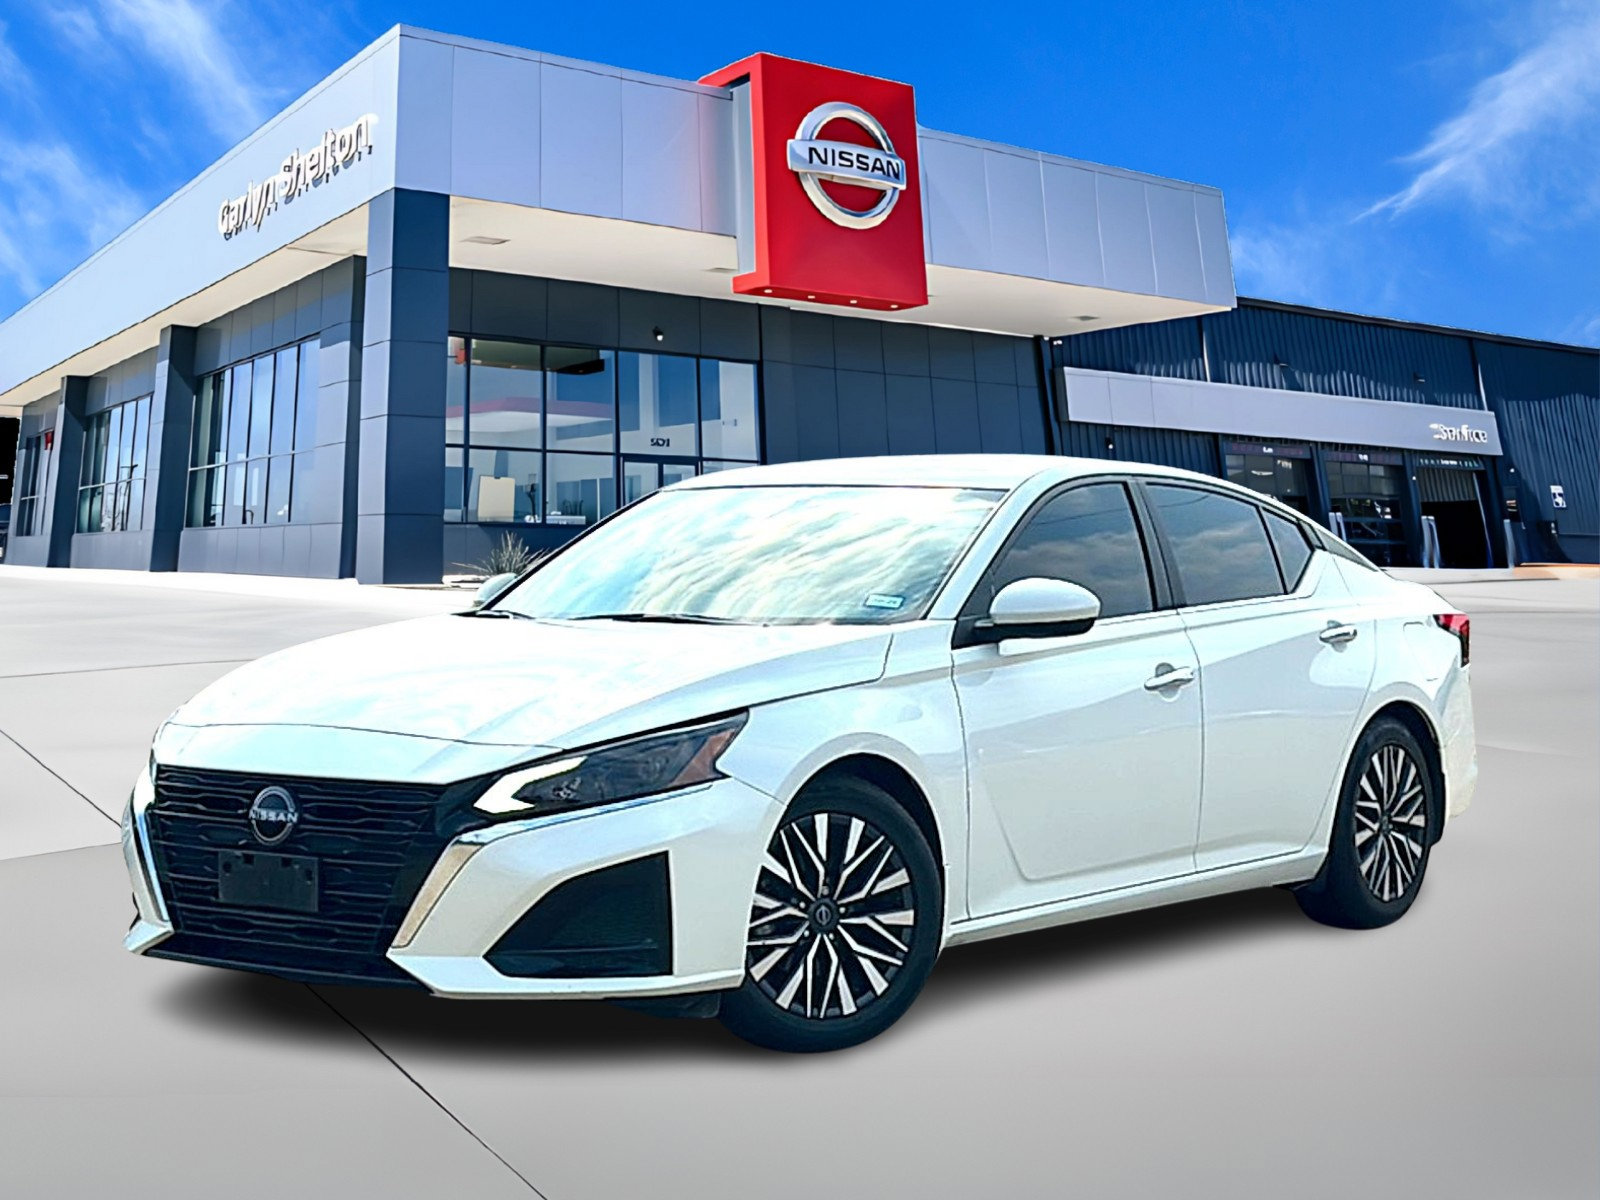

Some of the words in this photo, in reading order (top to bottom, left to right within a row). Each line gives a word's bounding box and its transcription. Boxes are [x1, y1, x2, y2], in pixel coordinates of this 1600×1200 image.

[280, 114, 374, 202] Shelton
[808, 147, 900, 180] NISSAN
[249, 808, 298, 823] NISSAN
